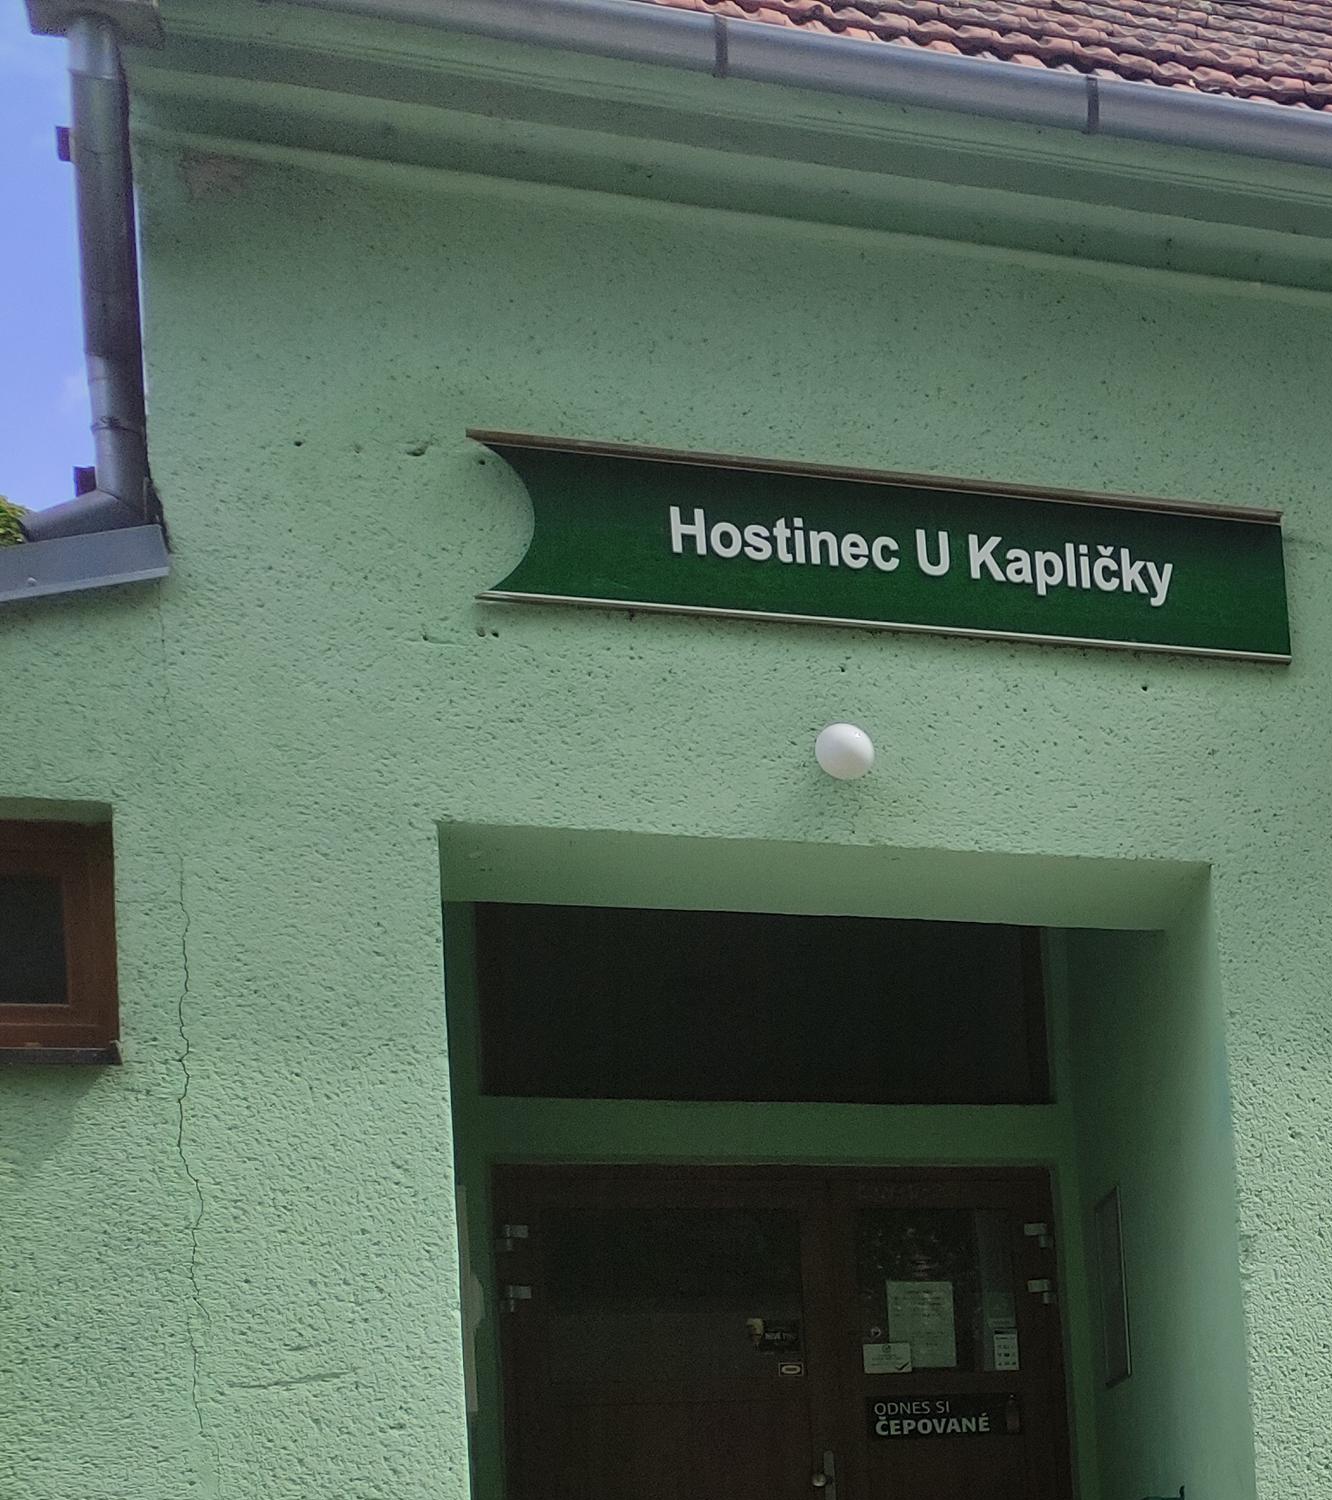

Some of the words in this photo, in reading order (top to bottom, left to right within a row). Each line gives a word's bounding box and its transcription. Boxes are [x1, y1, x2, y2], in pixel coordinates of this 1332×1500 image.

[669, 505, 900, 572] Hostinec
[915, 529, 950, 577] U
[968, 533, 1173, 607] Kapličky
[874, 1400, 931, 1417] ODNES
[936, 1400, 950, 1414] SI
[875, 1411, 991, 1436] ČEPOVANÉ
